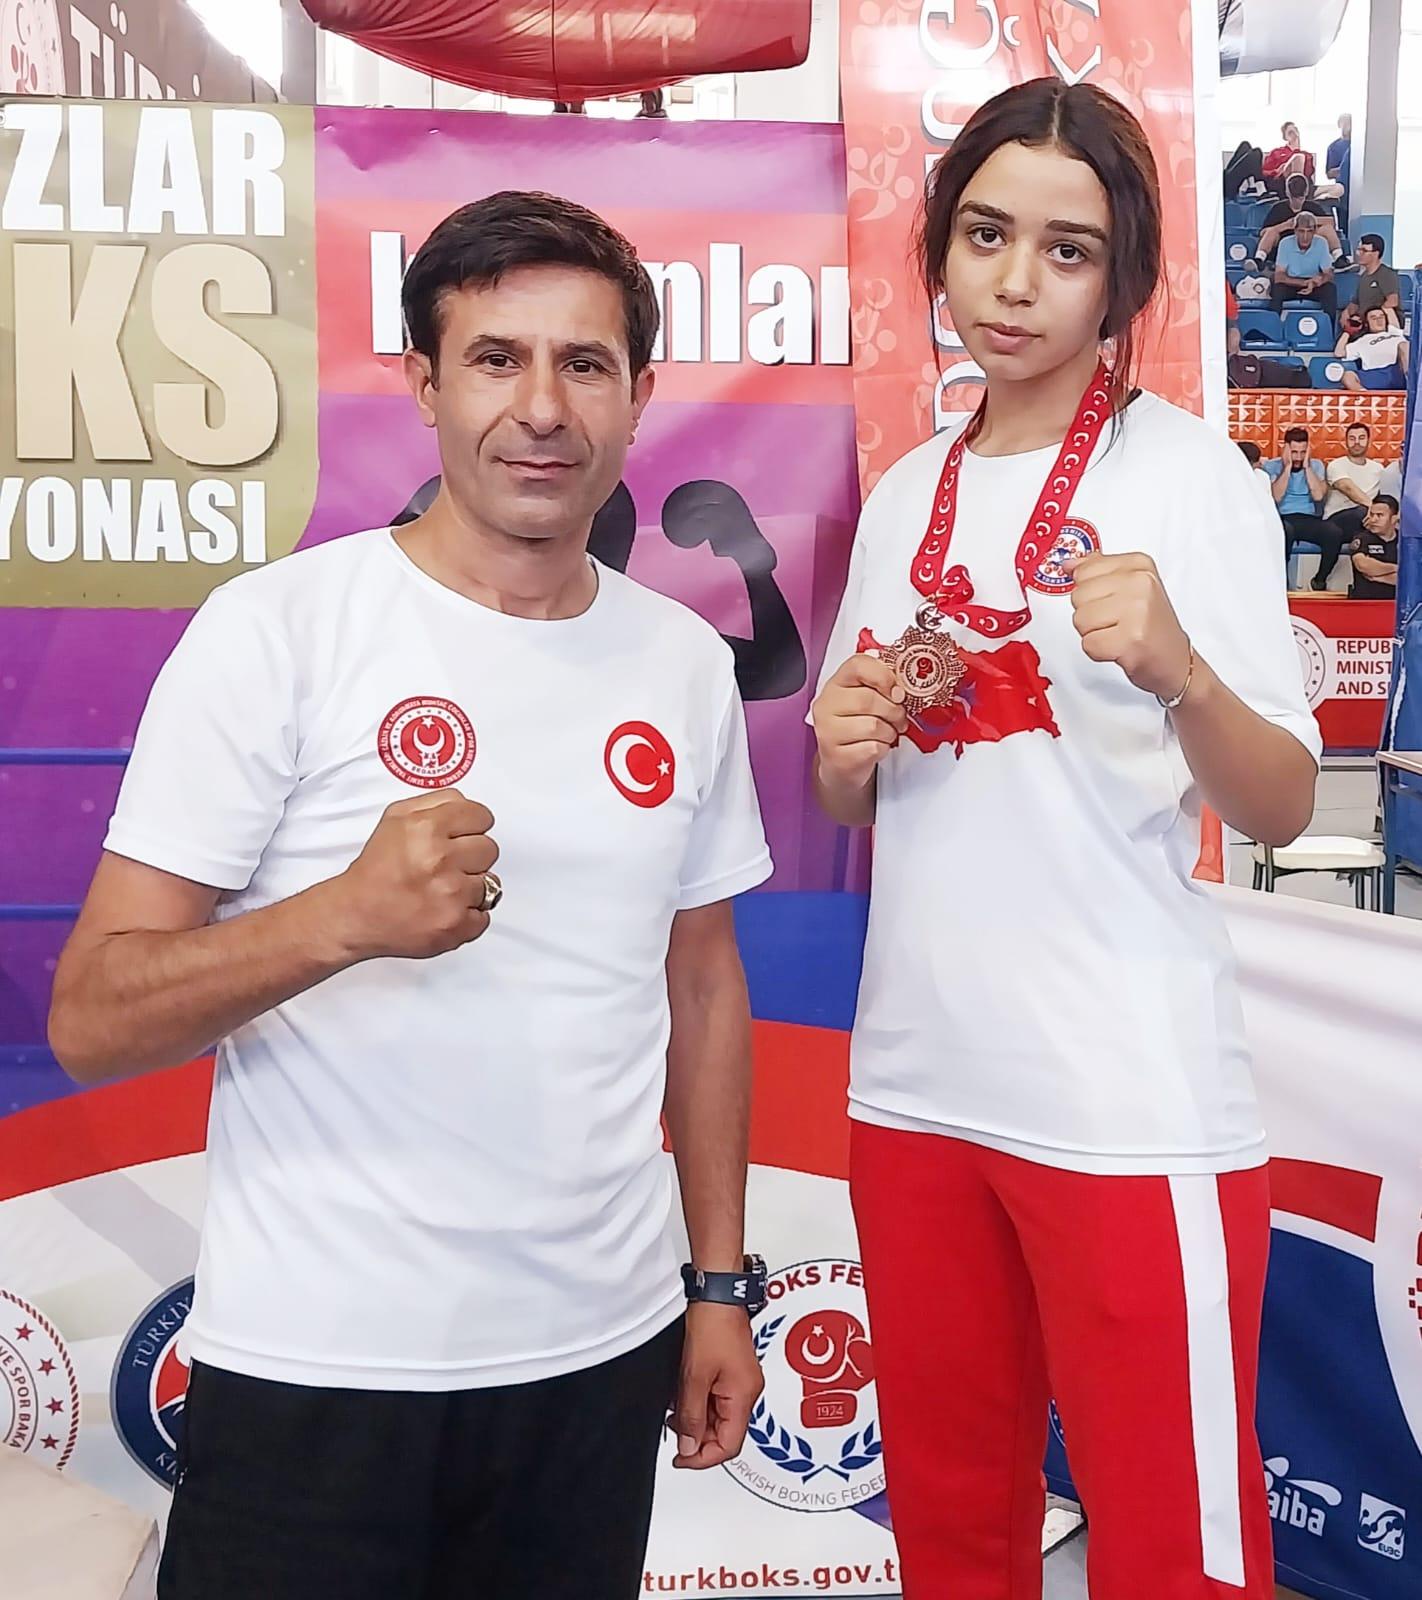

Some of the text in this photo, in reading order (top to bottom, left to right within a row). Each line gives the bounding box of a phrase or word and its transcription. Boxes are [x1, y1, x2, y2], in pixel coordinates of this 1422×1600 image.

[2, 104, 286, 236] ZLAR
[14, 243, 278, 466] KS
[1336, 640, 1391, 654] REPUB
[1336, 661, 1392, 674] MINIST
[1336, 681, 1391, 694] AND S
[767, 1266, 821, 1299] OKS
[830, 1264, 865, 1287] FE
[9, 1367, 31, 1409] SPOR
[817, 1405, 844, 1417] 1924
[9, 1413, 31, 1449] BAKA
[778, 1486, 837, 1505] BOXING
[1267, 1486, 1326, 1537] aiba
[643, 1558, 897, 1592] turkboks.gov.t
